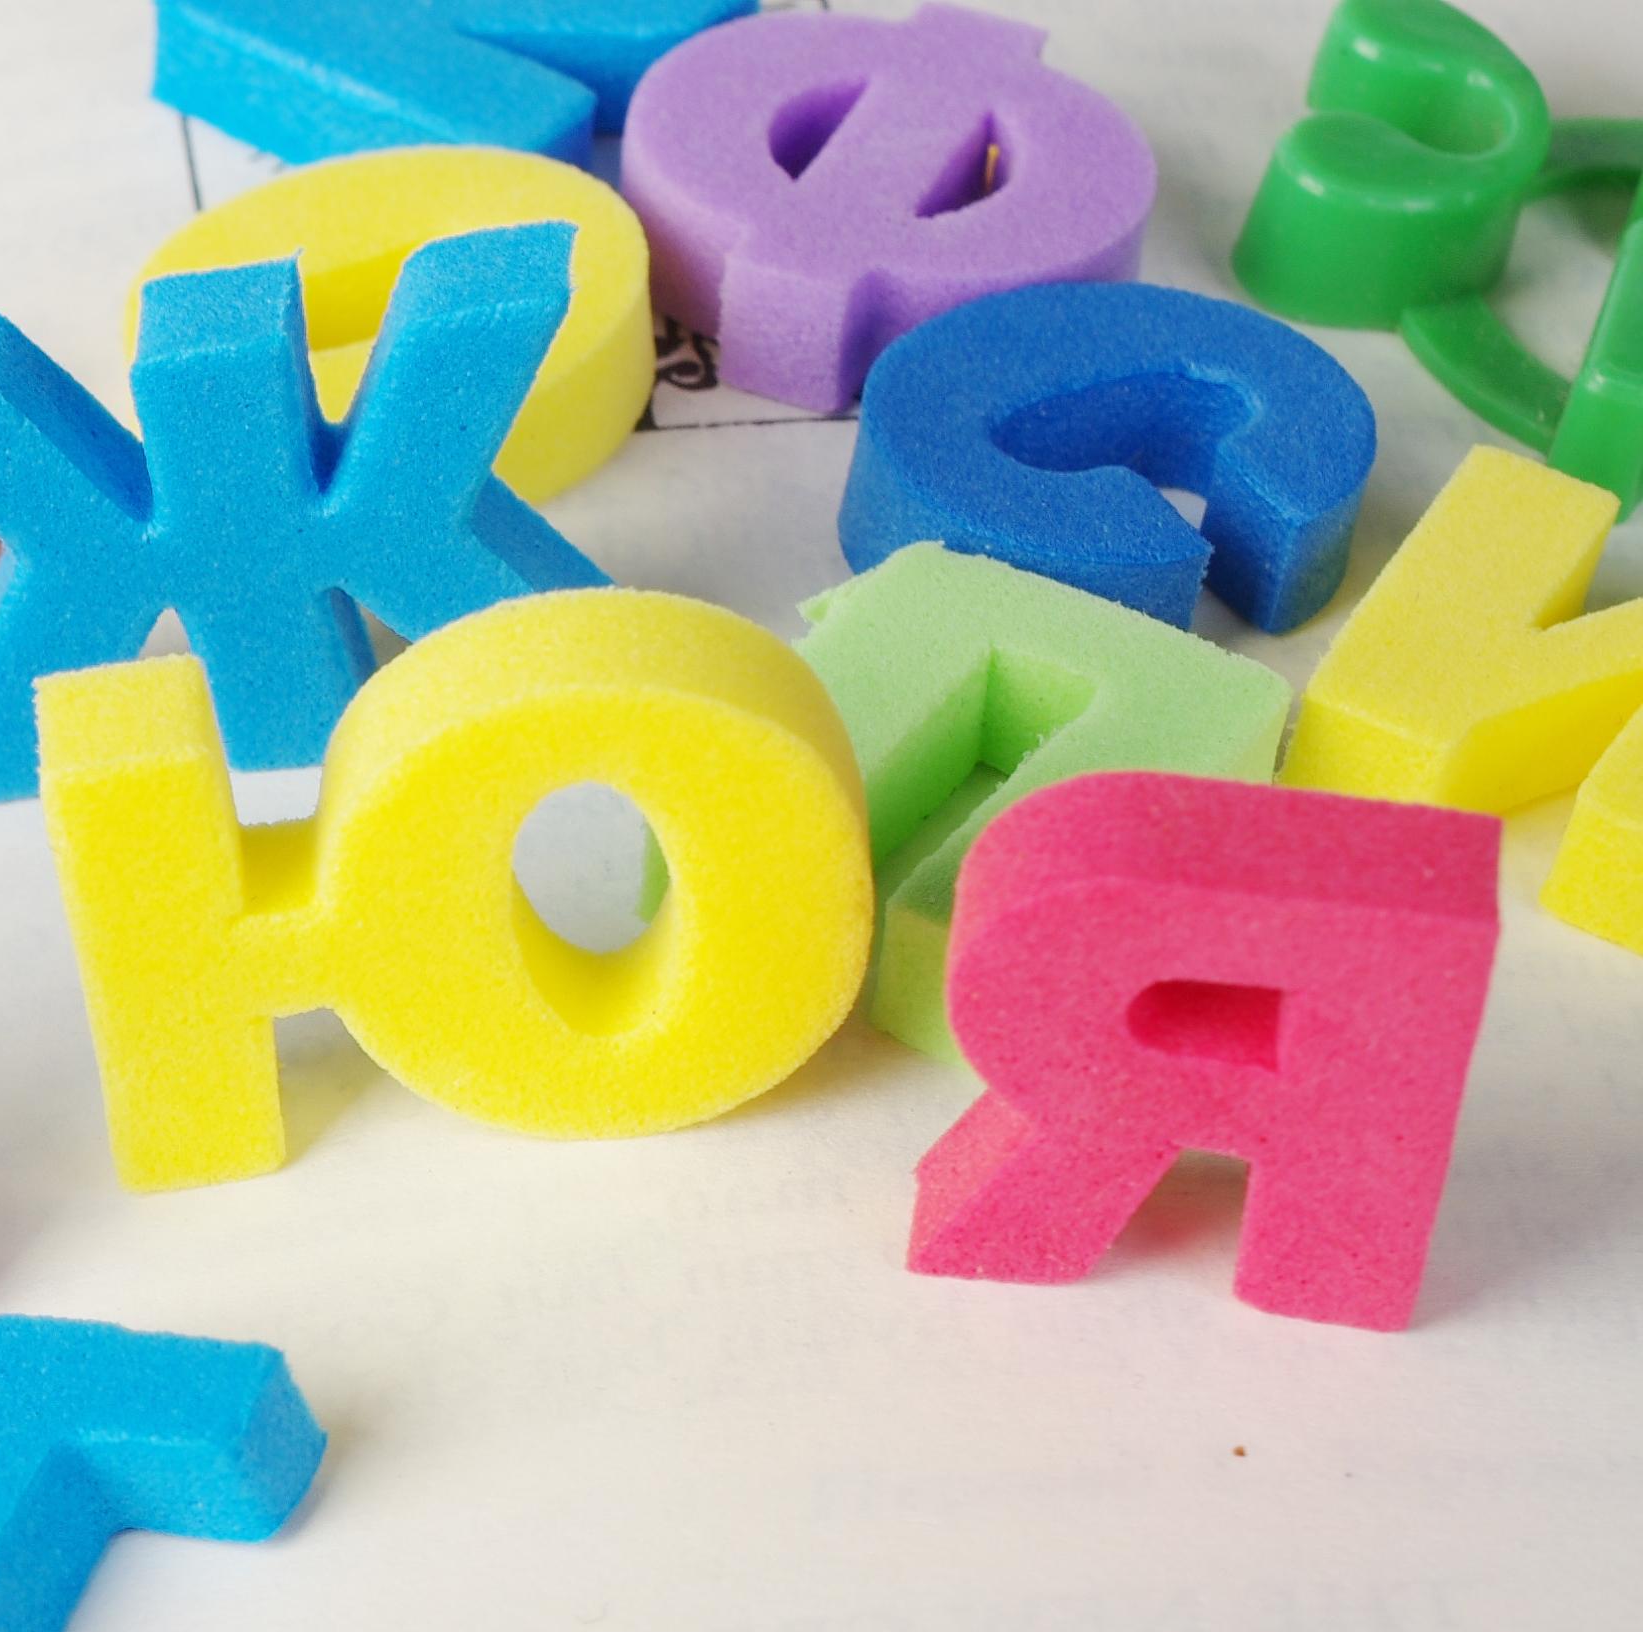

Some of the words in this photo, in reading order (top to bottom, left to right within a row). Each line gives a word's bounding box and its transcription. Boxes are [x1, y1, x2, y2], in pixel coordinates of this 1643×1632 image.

[622, 2, 1157, 413] Ф
[34, 589, 875, 1196] Ю
[906, 770, 1505, 1334] Я
